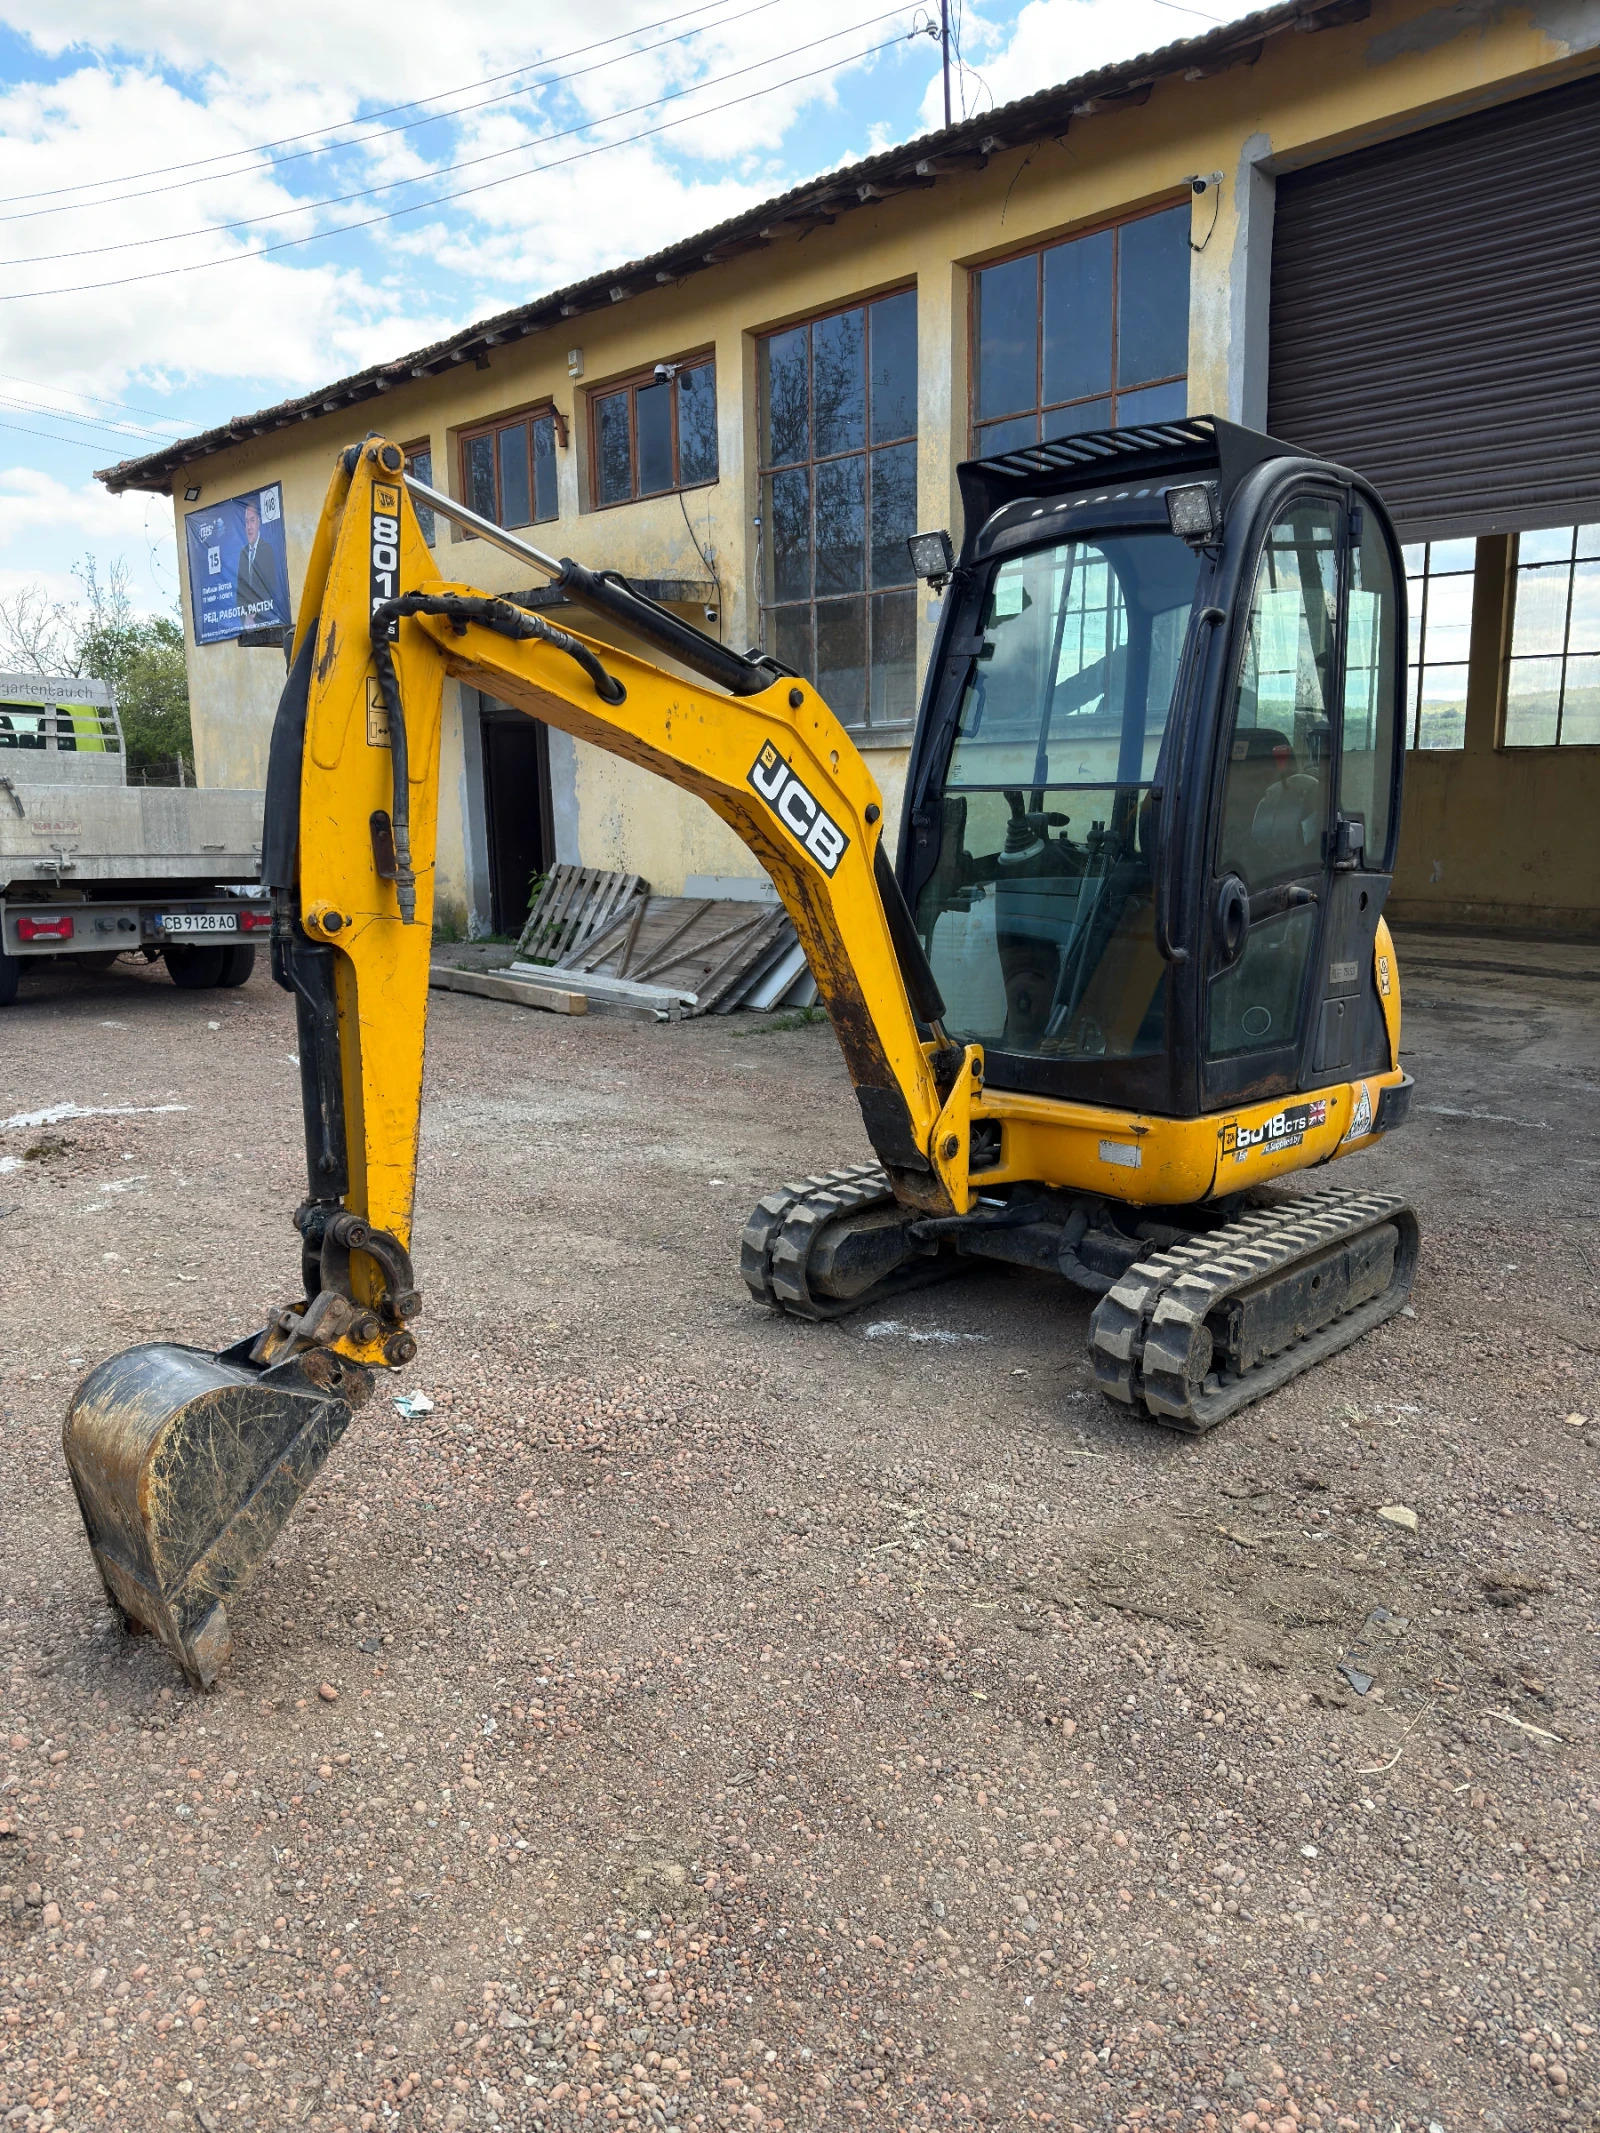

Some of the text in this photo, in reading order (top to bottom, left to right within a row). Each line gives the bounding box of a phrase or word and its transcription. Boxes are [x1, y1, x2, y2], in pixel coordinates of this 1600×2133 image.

[377, 490, 395, 508] JCB
[209, 552, 219, 568] 15
[203, 611, 218, 623] РЕД,
[220, 606, 247, 619] РАБОТА,
[753, 763, 844, 869] JCB
[164, 915, 235, 930] CB 9128 AO
